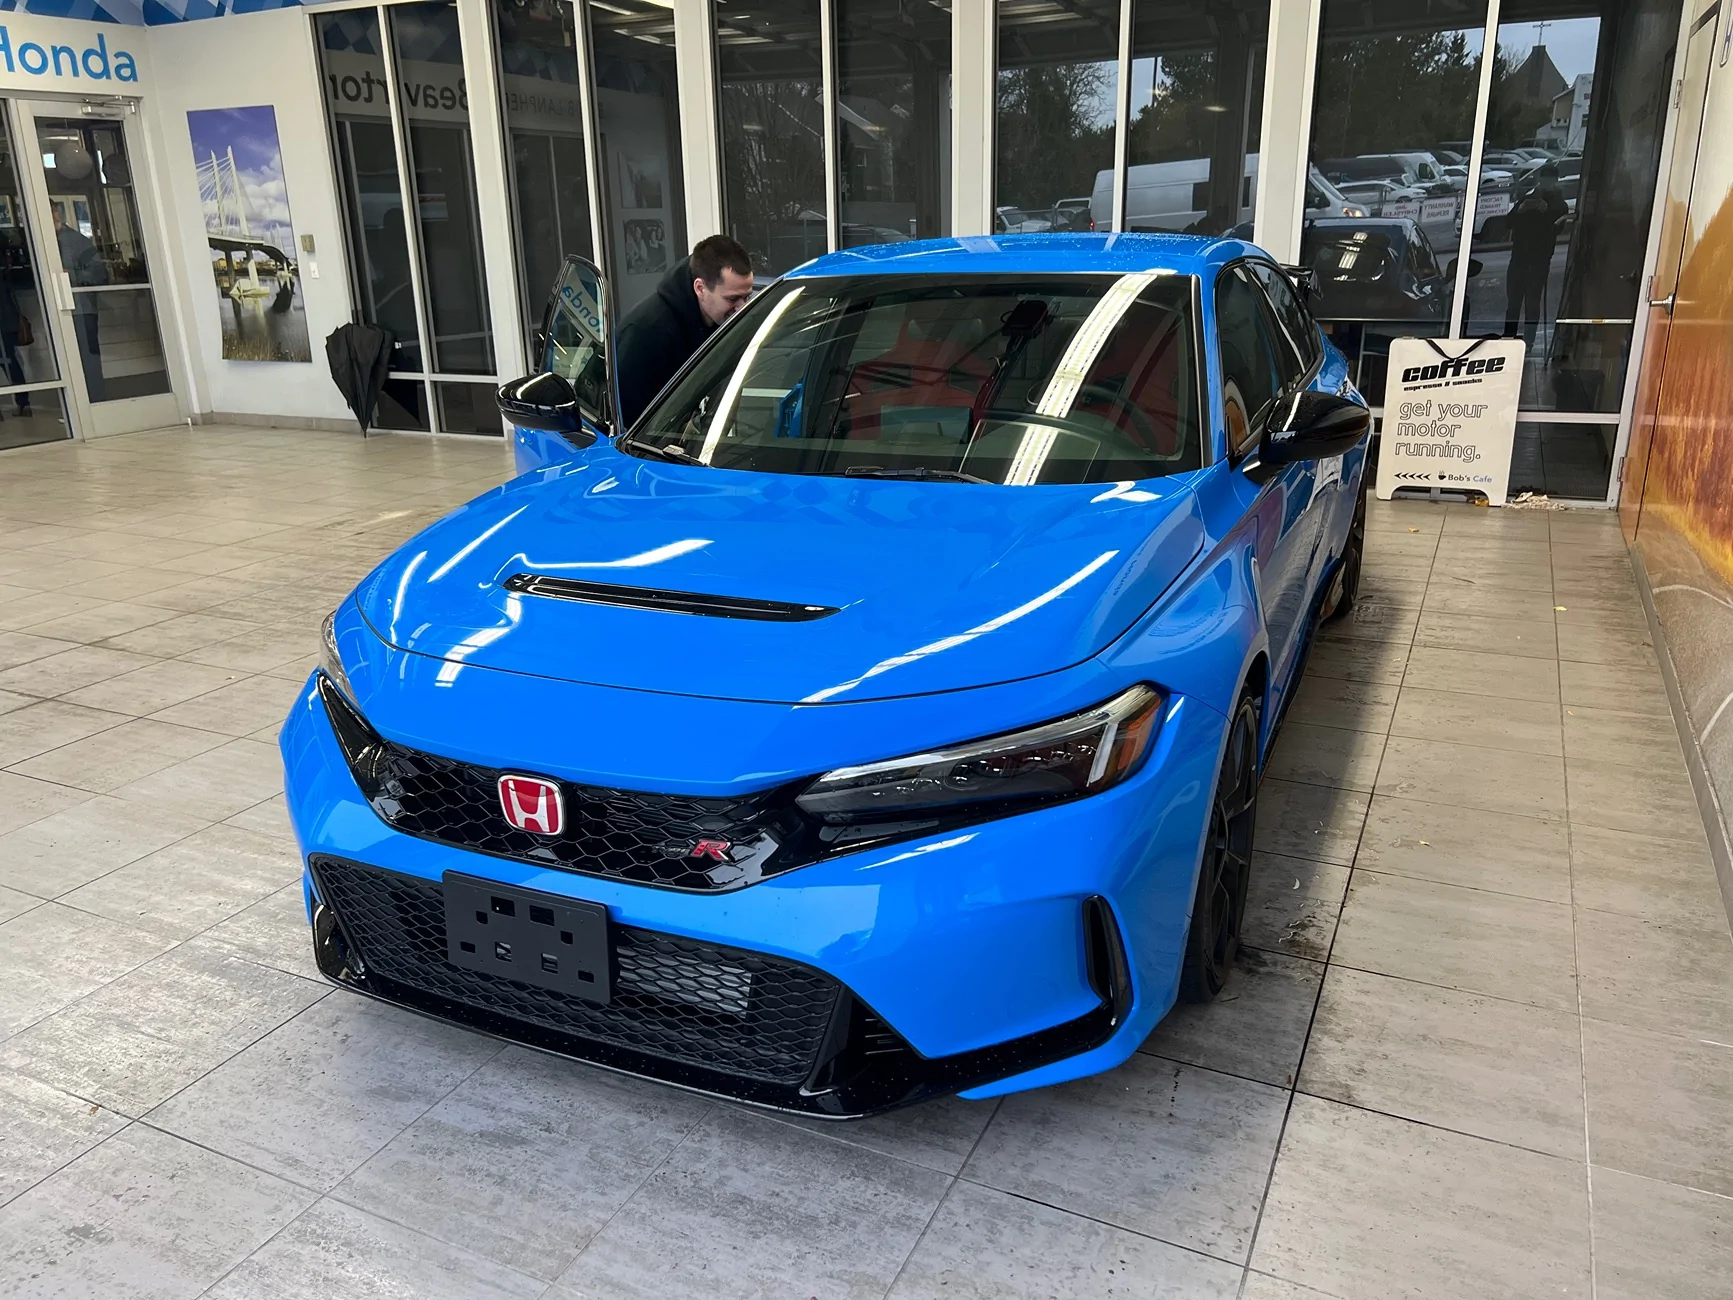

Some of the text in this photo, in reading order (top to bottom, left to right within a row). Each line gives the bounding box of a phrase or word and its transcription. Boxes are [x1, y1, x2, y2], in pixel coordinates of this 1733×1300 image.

[1401, 356, 1506, 383] coffee
[1399, 400, 1488, 421] get your
[1397, 419, 1462, 438] motor
[1395, 440, 1481, 463] running.
[1448, 473, 1493, 483] Bob's Cafe
